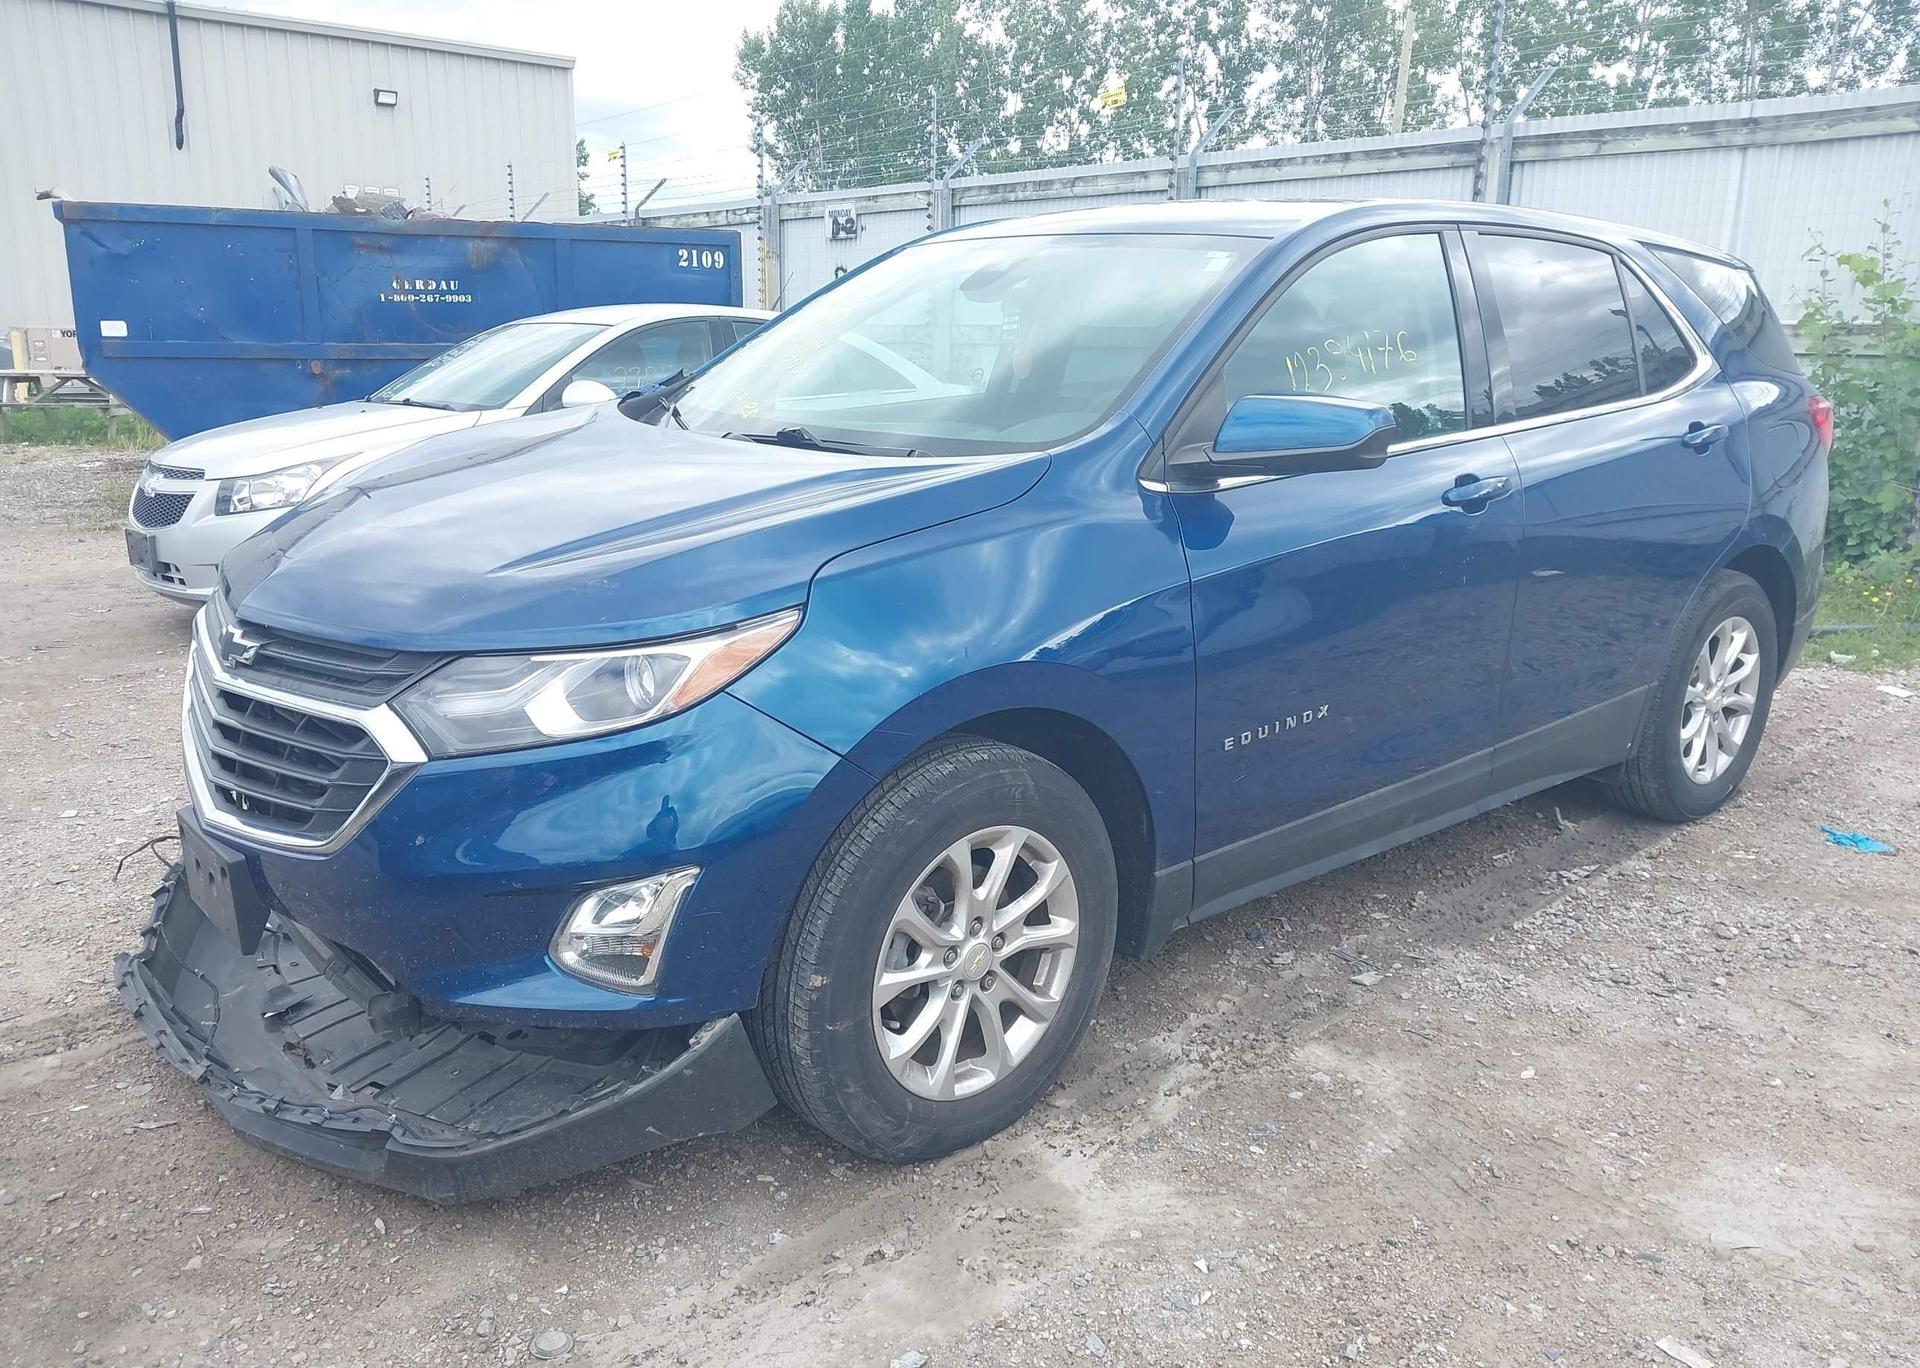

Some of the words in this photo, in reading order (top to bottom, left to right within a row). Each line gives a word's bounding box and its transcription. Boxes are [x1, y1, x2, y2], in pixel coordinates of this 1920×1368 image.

[678, 248, 724, 269] 2109
[392, 279, 459, 291] GERDAU
[1224, 704, 1329, 751] EQUINOX
